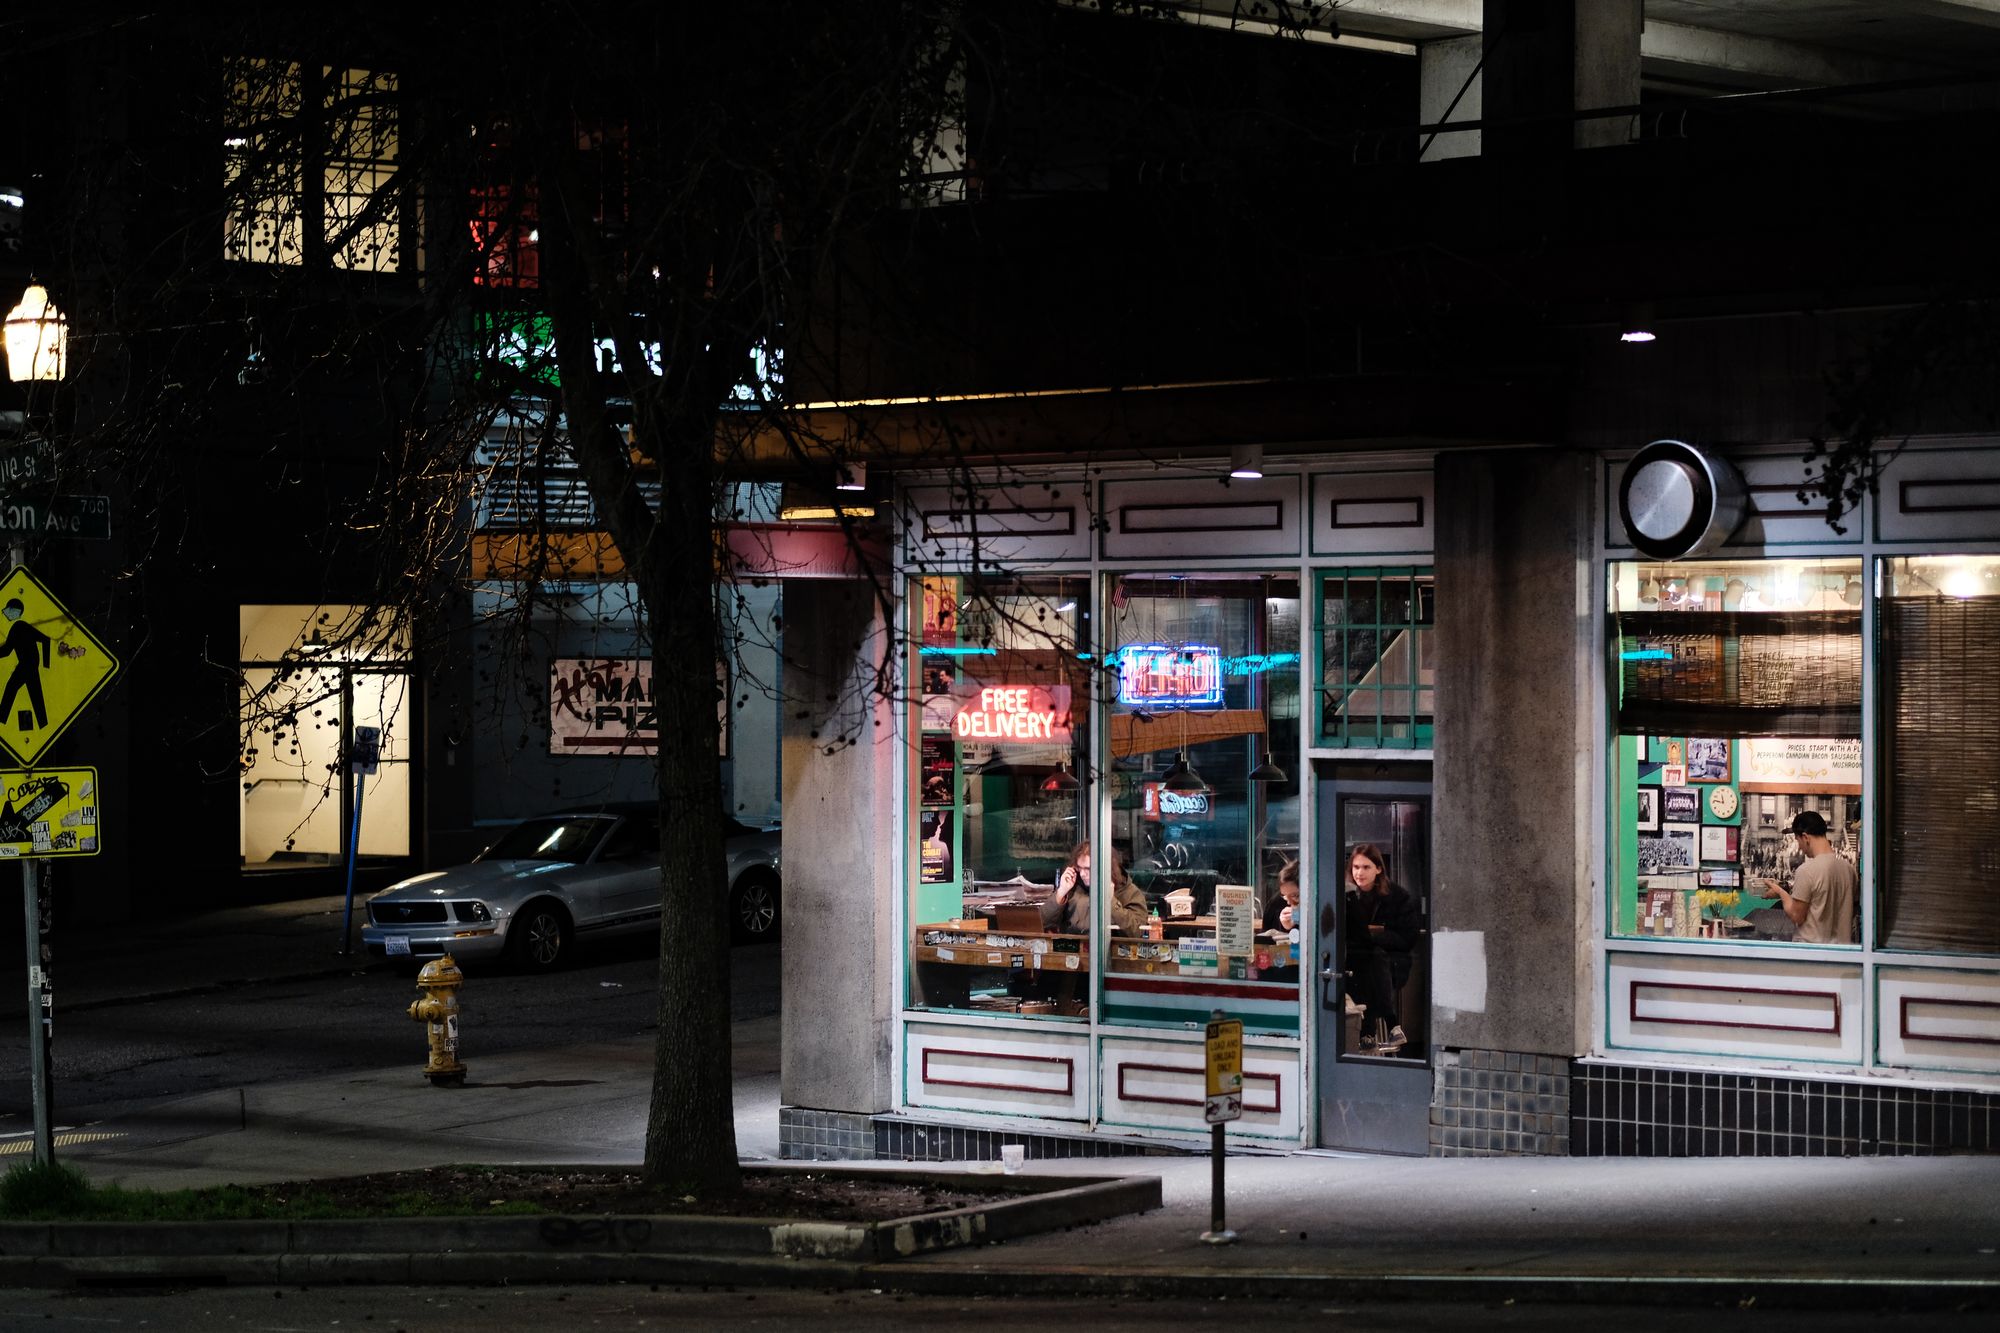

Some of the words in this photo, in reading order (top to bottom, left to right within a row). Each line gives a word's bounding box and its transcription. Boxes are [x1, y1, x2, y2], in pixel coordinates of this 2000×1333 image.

[81, 499, 105, 514] 700
[45, 511, 81, 532] Ave
[981, 688, 1029, 713] FREE
[957, 711, 1054, 739] DELIVERY
[1788, 744, 1805, 752] PRICES
[1809, 744, 1827, 752] START
[1193, 944, 1217, 952] EMPLOYEES
[1210, 1040, 1225, 1050] LOAD
[1227, 1039, 1238, 1049] AND
[1213, 1050, 1236, 1061] UNLOAD
[1217, 1062, 1232, 1073] ONLY
